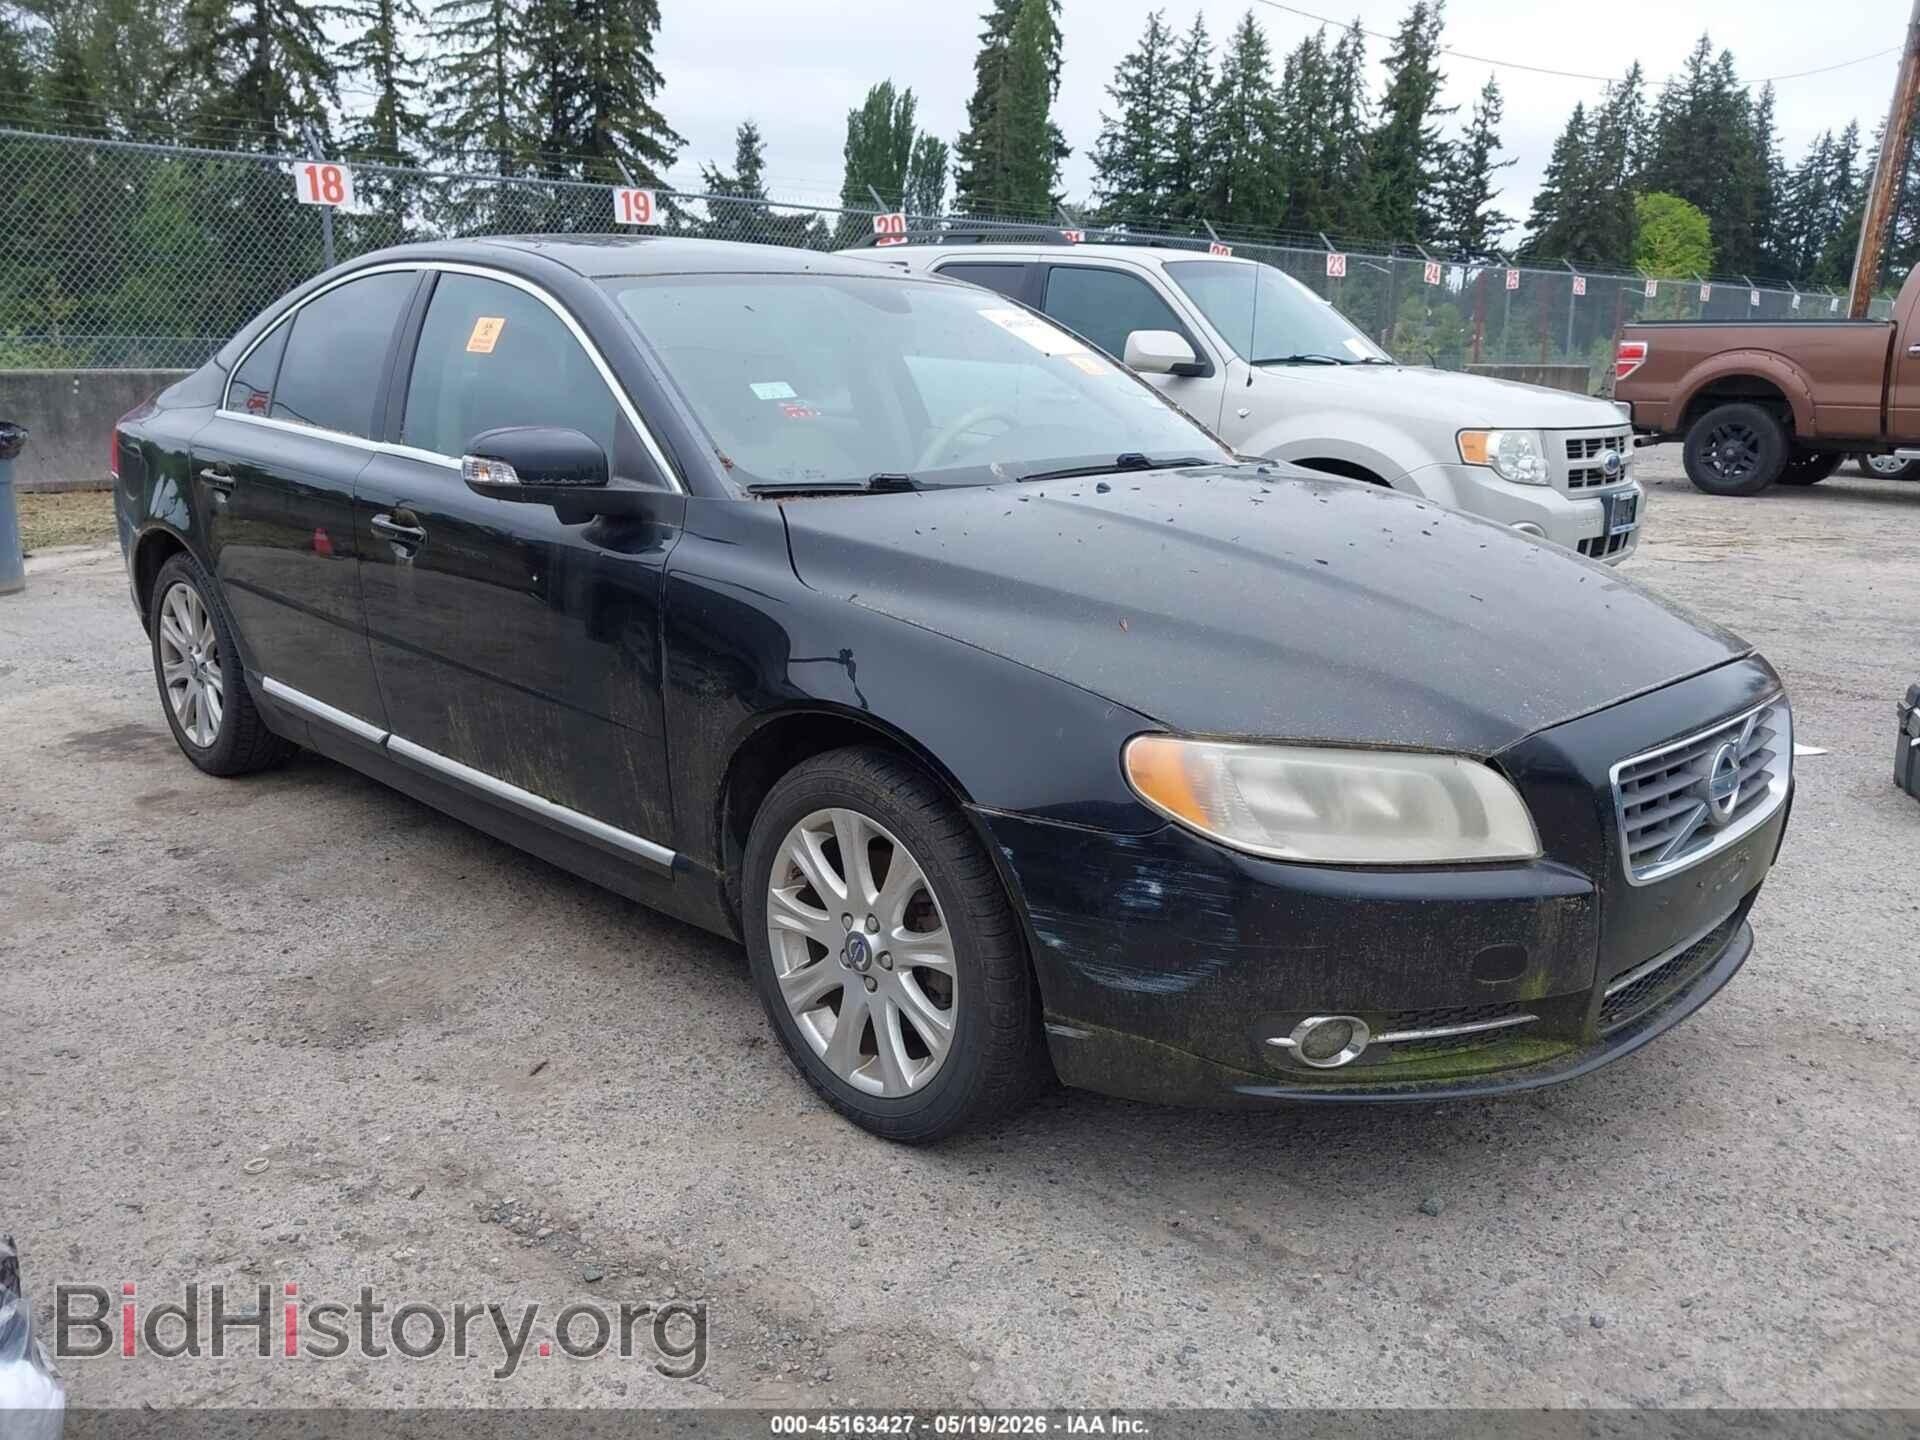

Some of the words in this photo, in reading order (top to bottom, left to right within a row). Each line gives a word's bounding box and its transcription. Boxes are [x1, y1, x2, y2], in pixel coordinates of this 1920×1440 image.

[304, 165, 345, 203] 18
[621, 191, 650, 223] 19
[877, 215, 903, 244] 20
[1328, 255, 1344, 275] 23
[1425, 263, 1439, 283] 24
